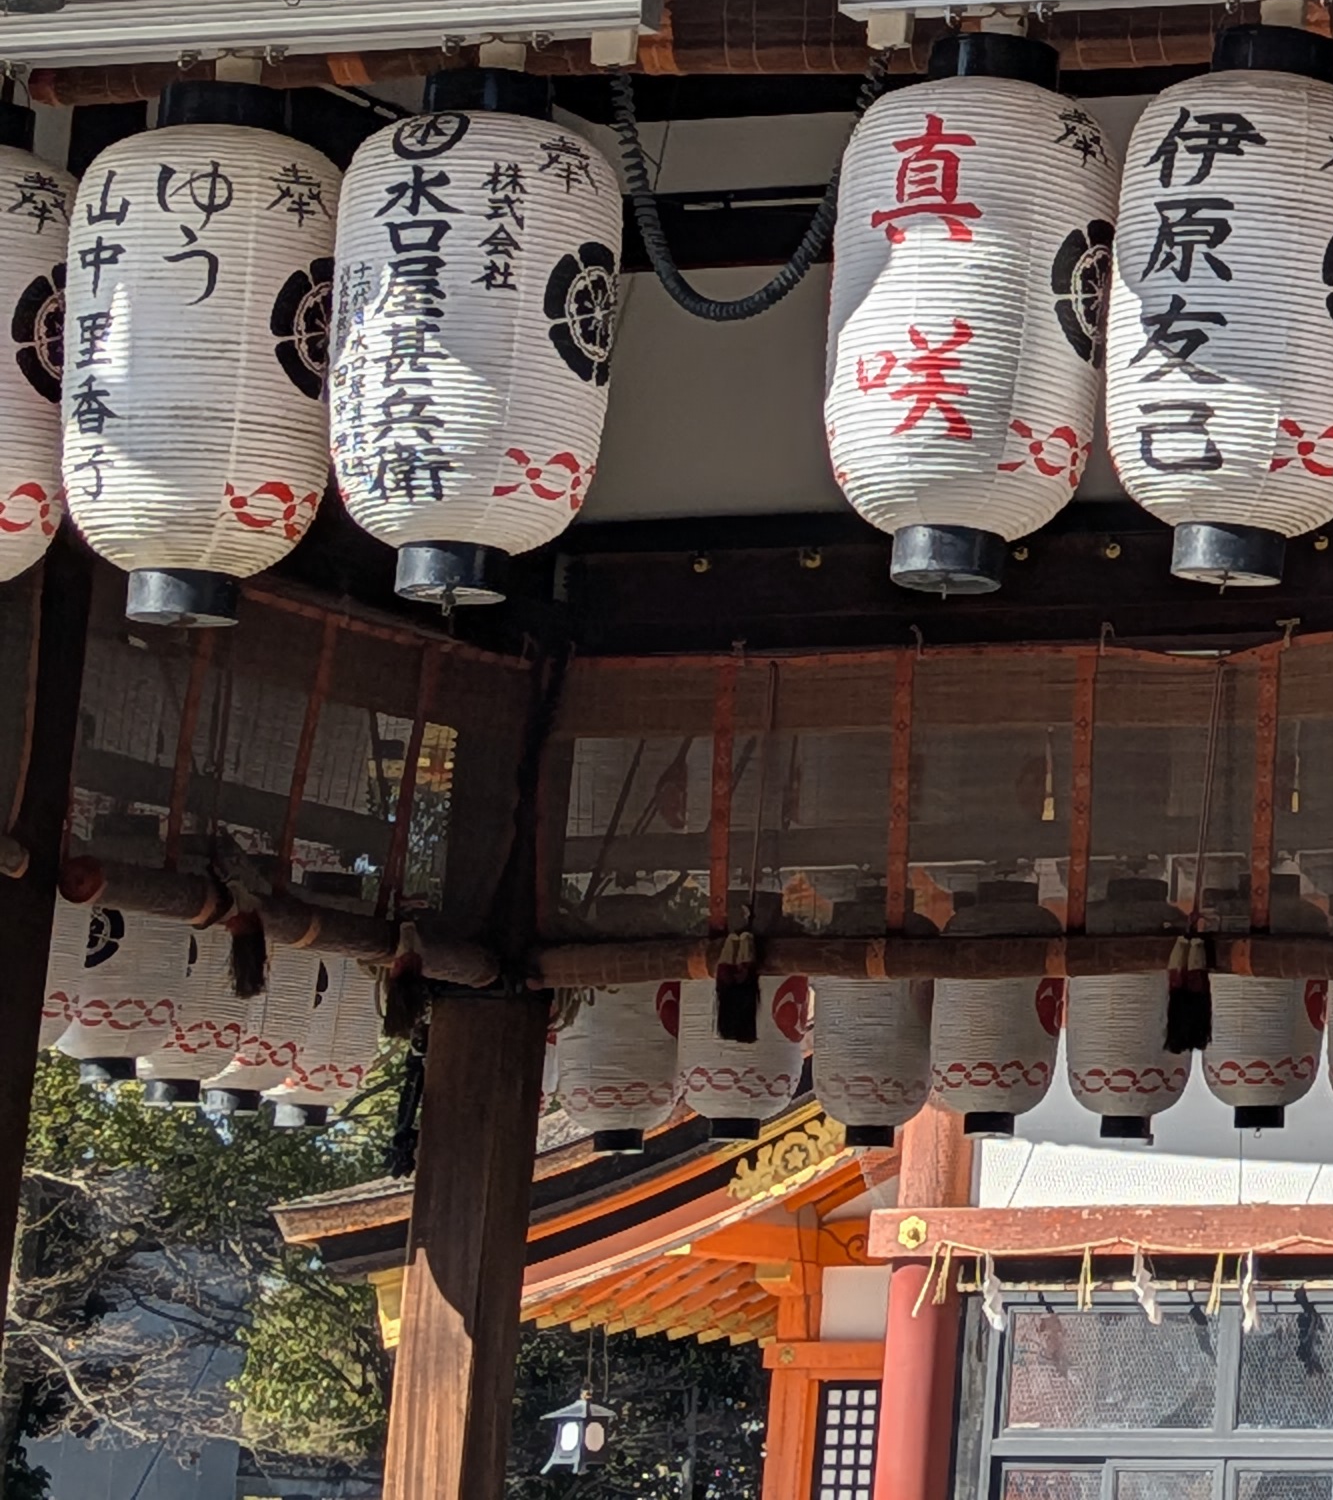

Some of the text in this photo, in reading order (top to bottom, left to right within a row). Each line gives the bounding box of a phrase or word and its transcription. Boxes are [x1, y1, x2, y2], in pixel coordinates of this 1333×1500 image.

[71, 169, 131, 502] 山中里香子
[158, 161, 234, 306] ゆう
[471, 162, 530, 292] 株式会社
[857, 113, 983, 440] 真咲
[1127, 106, 1267, 473] 伊原友己
